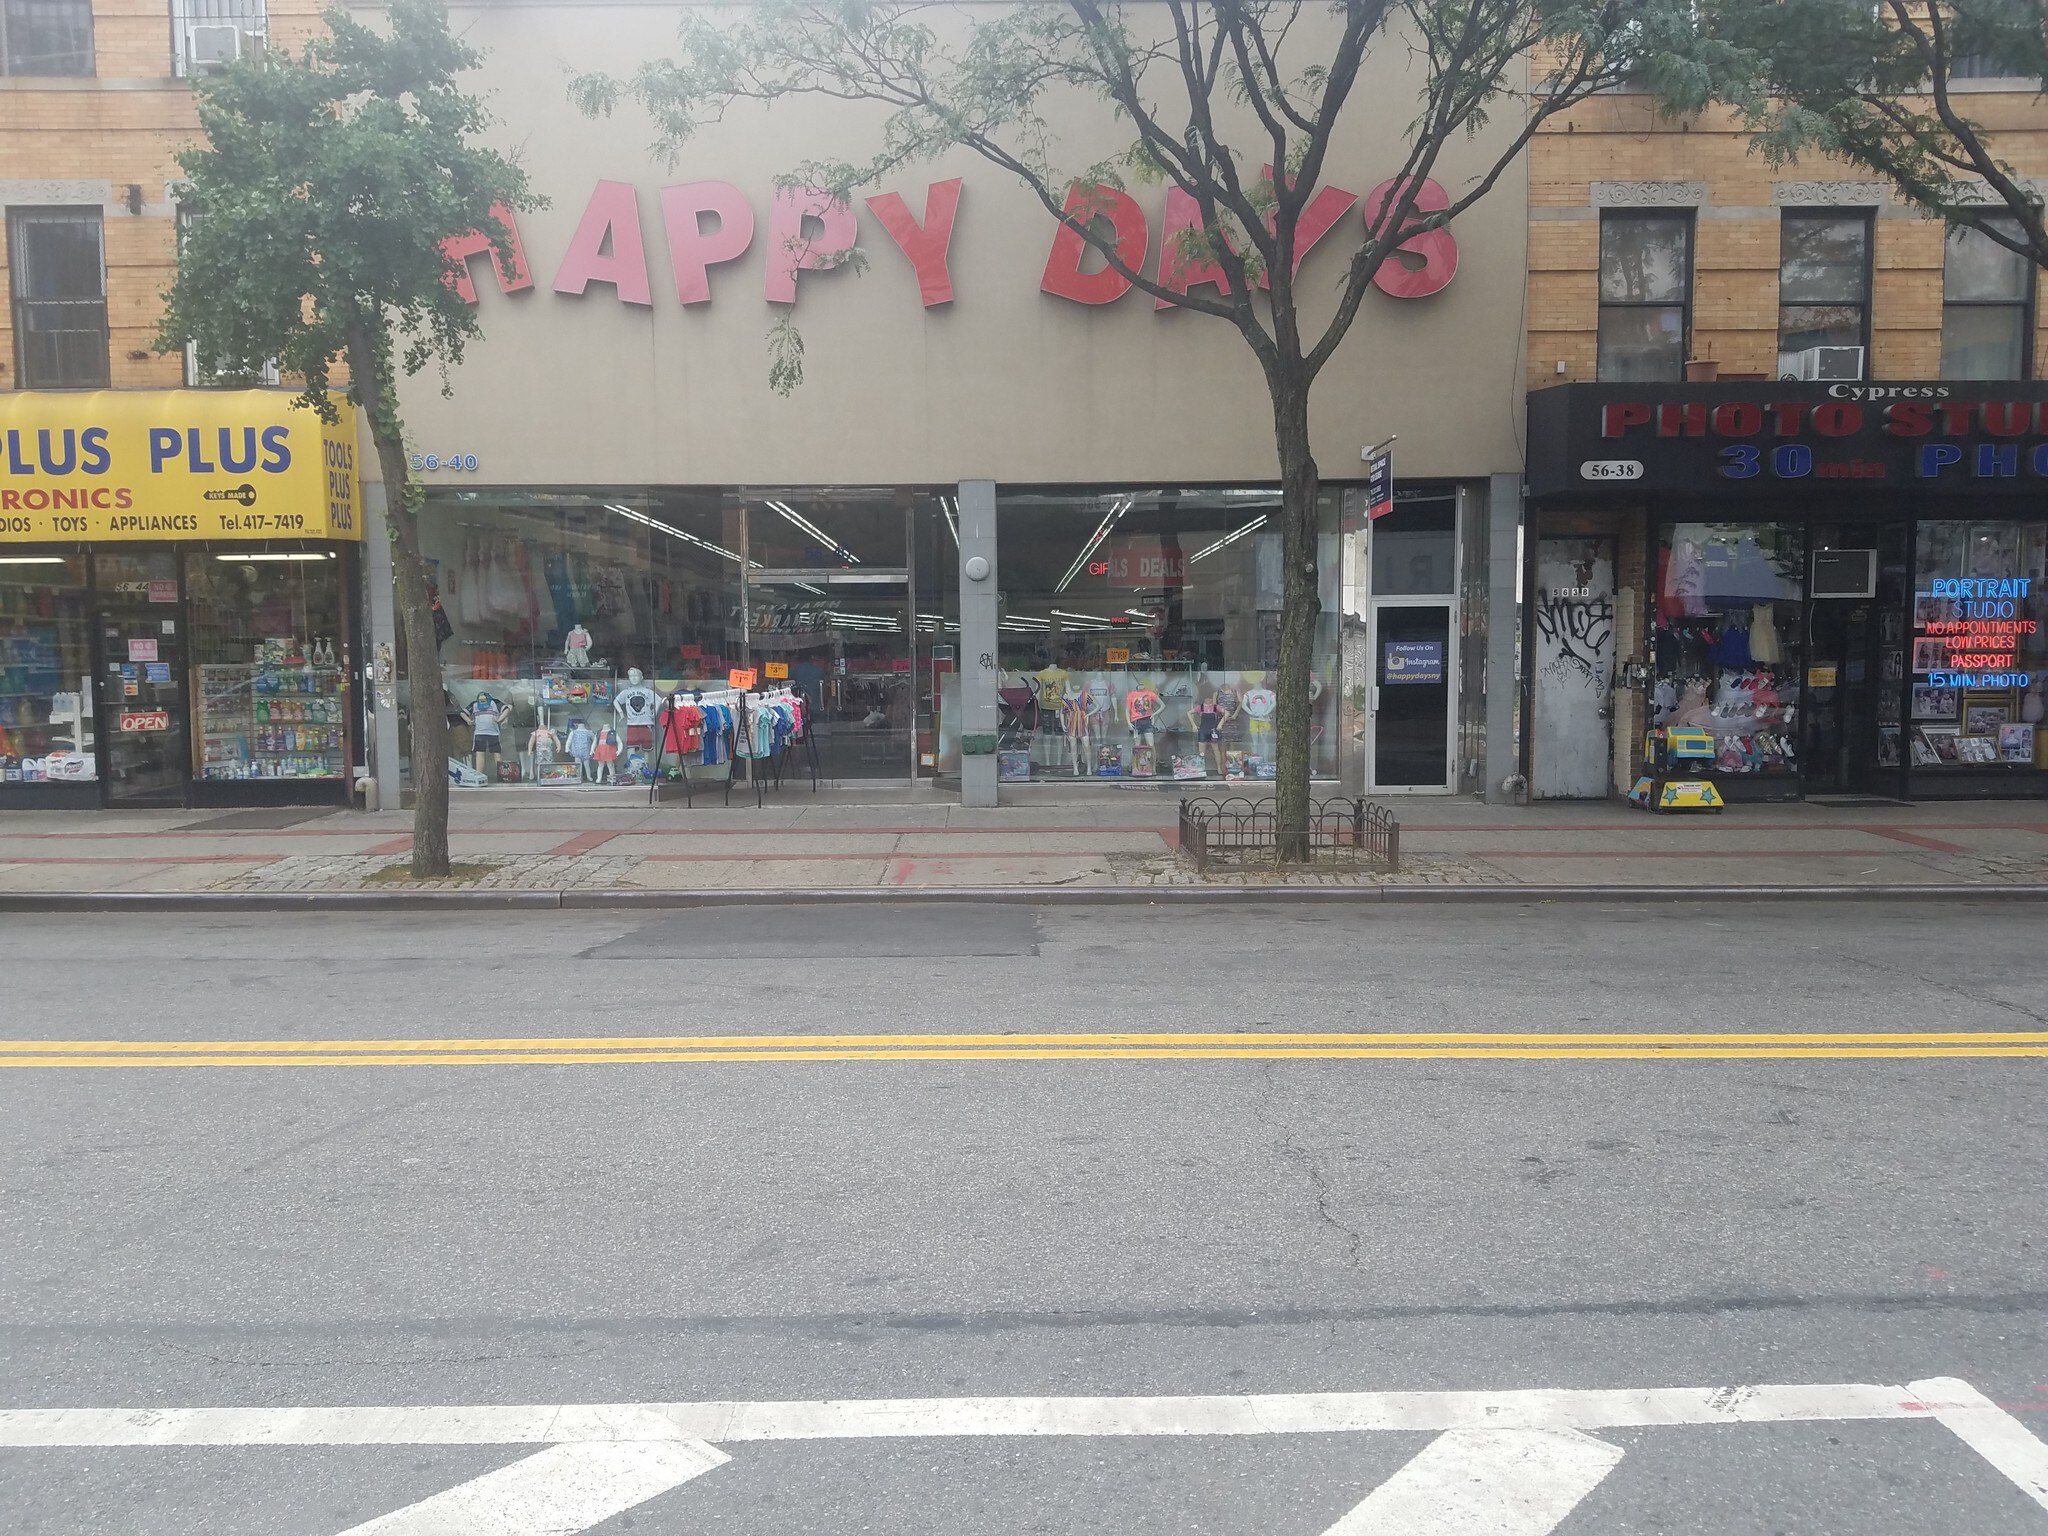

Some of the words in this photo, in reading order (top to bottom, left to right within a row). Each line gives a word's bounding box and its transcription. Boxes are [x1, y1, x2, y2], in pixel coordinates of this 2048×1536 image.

[437, 177, 963, 306] HAPPY
[1040, 163, 1458, 312] DAYS
[1828, 384, 1950, 400] Cypress
[1602, 402, 1862, 438] PHOTO
[0, 427, 111, 475] LUS
[149, 426, 292, 474] PLUS
[323, 439, 352, 470] TOOLS
[410, 453, 478, 471] 56-40
[1719, 444, 1812, 478] 30
[1591, 464, 1635, 477] 56-38
[329, 471, 350, 499] PLUS
[1, 487, 133, 511] RONICS
[208, 491, 225, 499] KEYS
[227, 491, 247, 499] MADE
[52, 516, 88, 532] TOYS
[110, 514, 198, 531] APPLIANCES
[331, 502, 352, 530] PLUS
[1140, 557, 1184, 577] DEALS
[116, 582, 129, 591] 56
[136, 582, 149, 591] 44
[1931, 578, 2031, 598] PORTRAIT
[1952, 600, 2014, 619] STUDIO
[1926, 620, 1945, 635] NO
[1946, 620, 2037, 634] APPOINTMENTS
[1945, 635, 1972, 649] LOW
[1974, 635, 2015, 649] PRICES
[1405, 657, 1440, 668] Instagram
[1950, 654, 2013, 668] PASSPORT
[1386, 672, 1441, 681] @happydaysny
[1928, 671, 1945, 688] 15
[1982, 673, 2029, 688] PHOTO
[122, 716, 167, 730] OPEN
